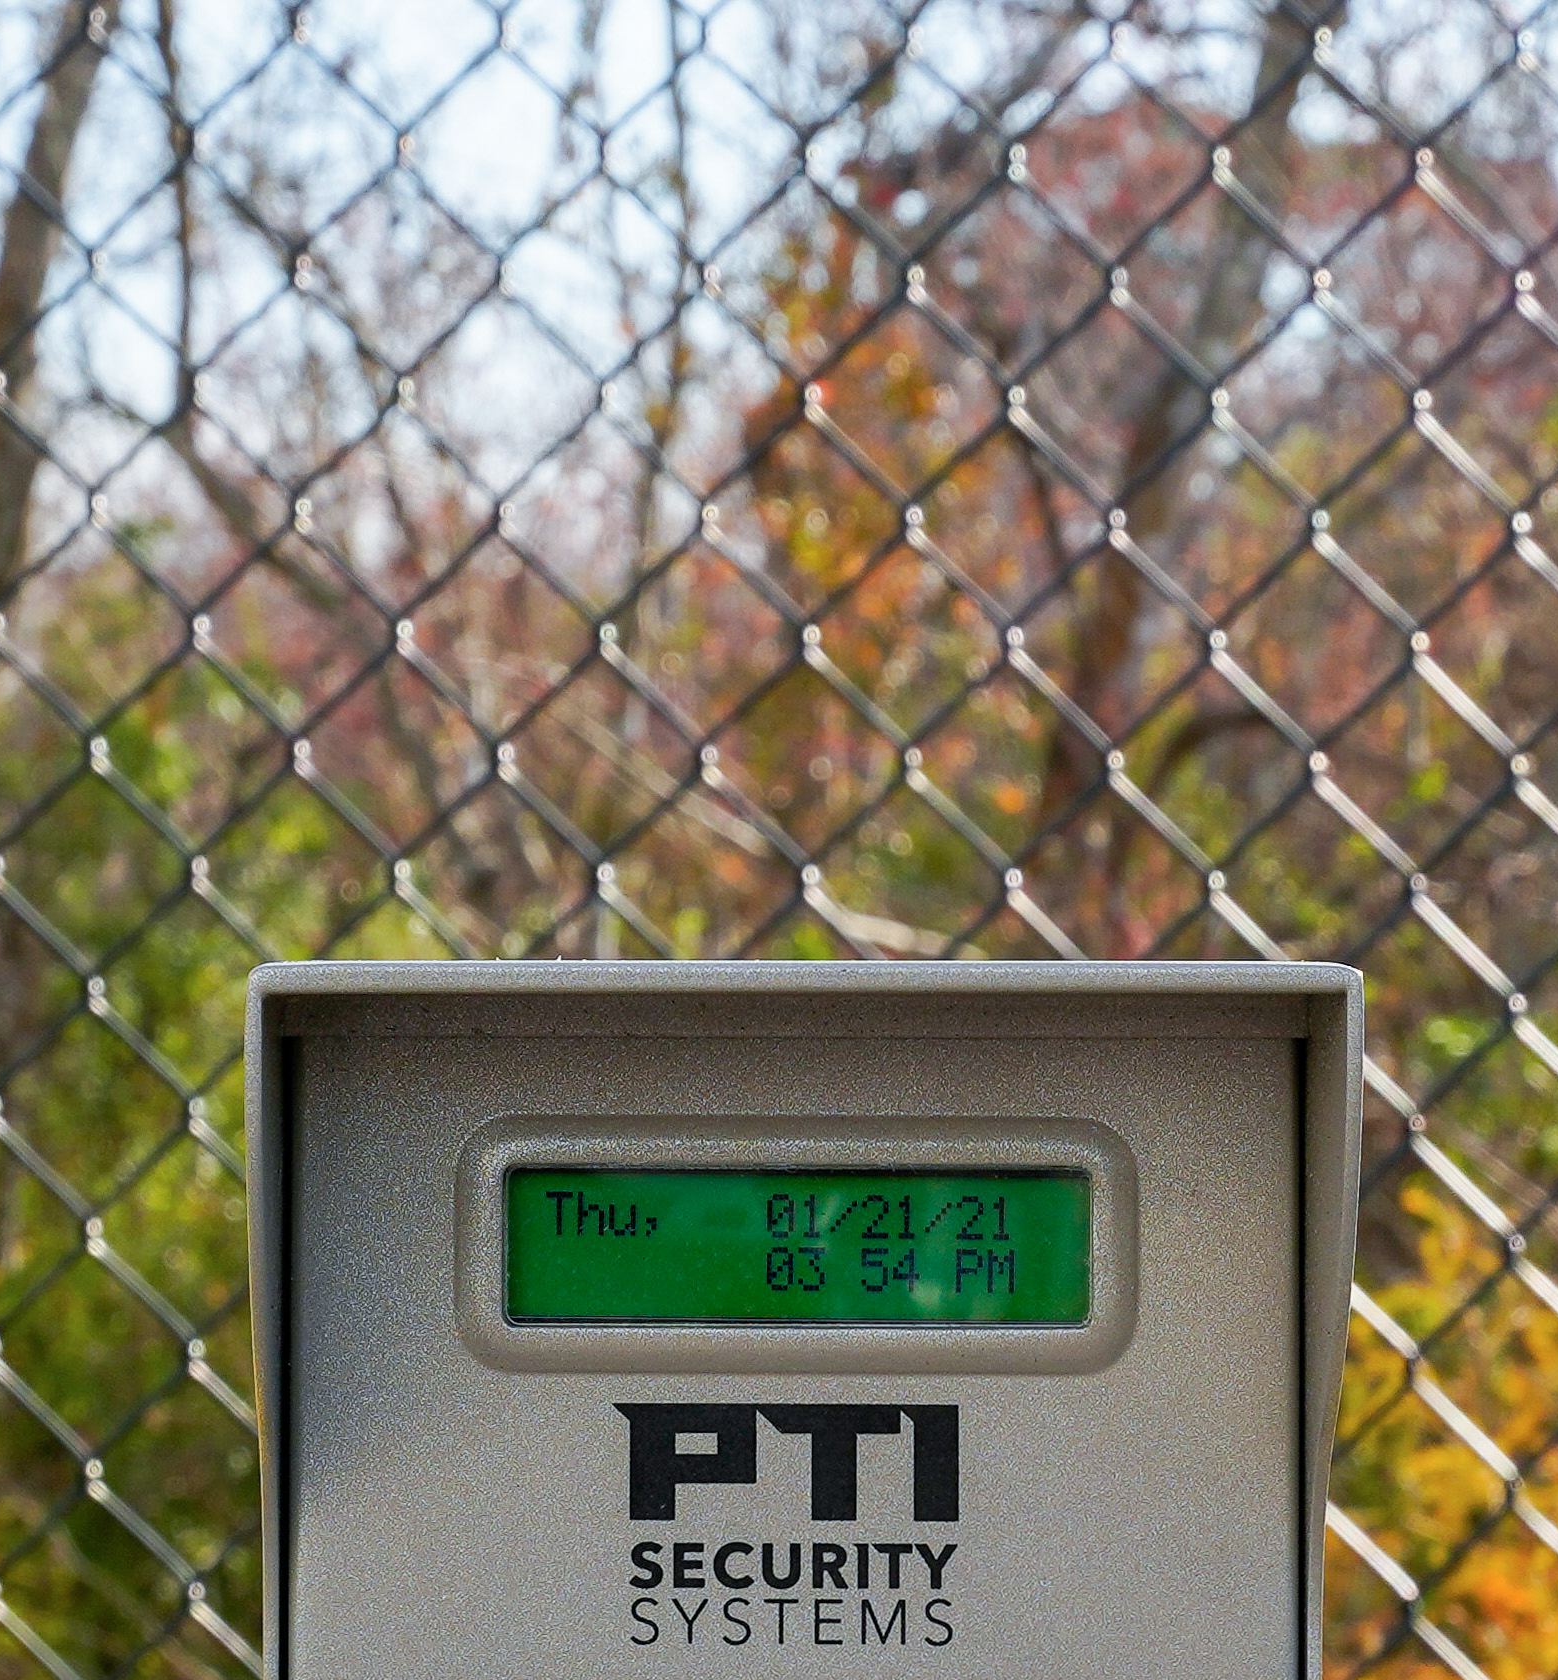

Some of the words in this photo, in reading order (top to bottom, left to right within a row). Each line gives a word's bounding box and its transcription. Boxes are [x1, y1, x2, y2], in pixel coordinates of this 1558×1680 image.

[544, 1190, 657, 1237] Thu,
[765, 1193, 1010, 1240] 01/21/21
[765, 1245, 826, 1292] 03
[860, 1247, 921, 1293] 54
[954, 1248, 1016, 1294] PM
[612, 1402, 960, 1522] PTI
[628, 1541, 960, 1591] SECURITY
[629, 1597, 955, 1647] SYSTEMS
